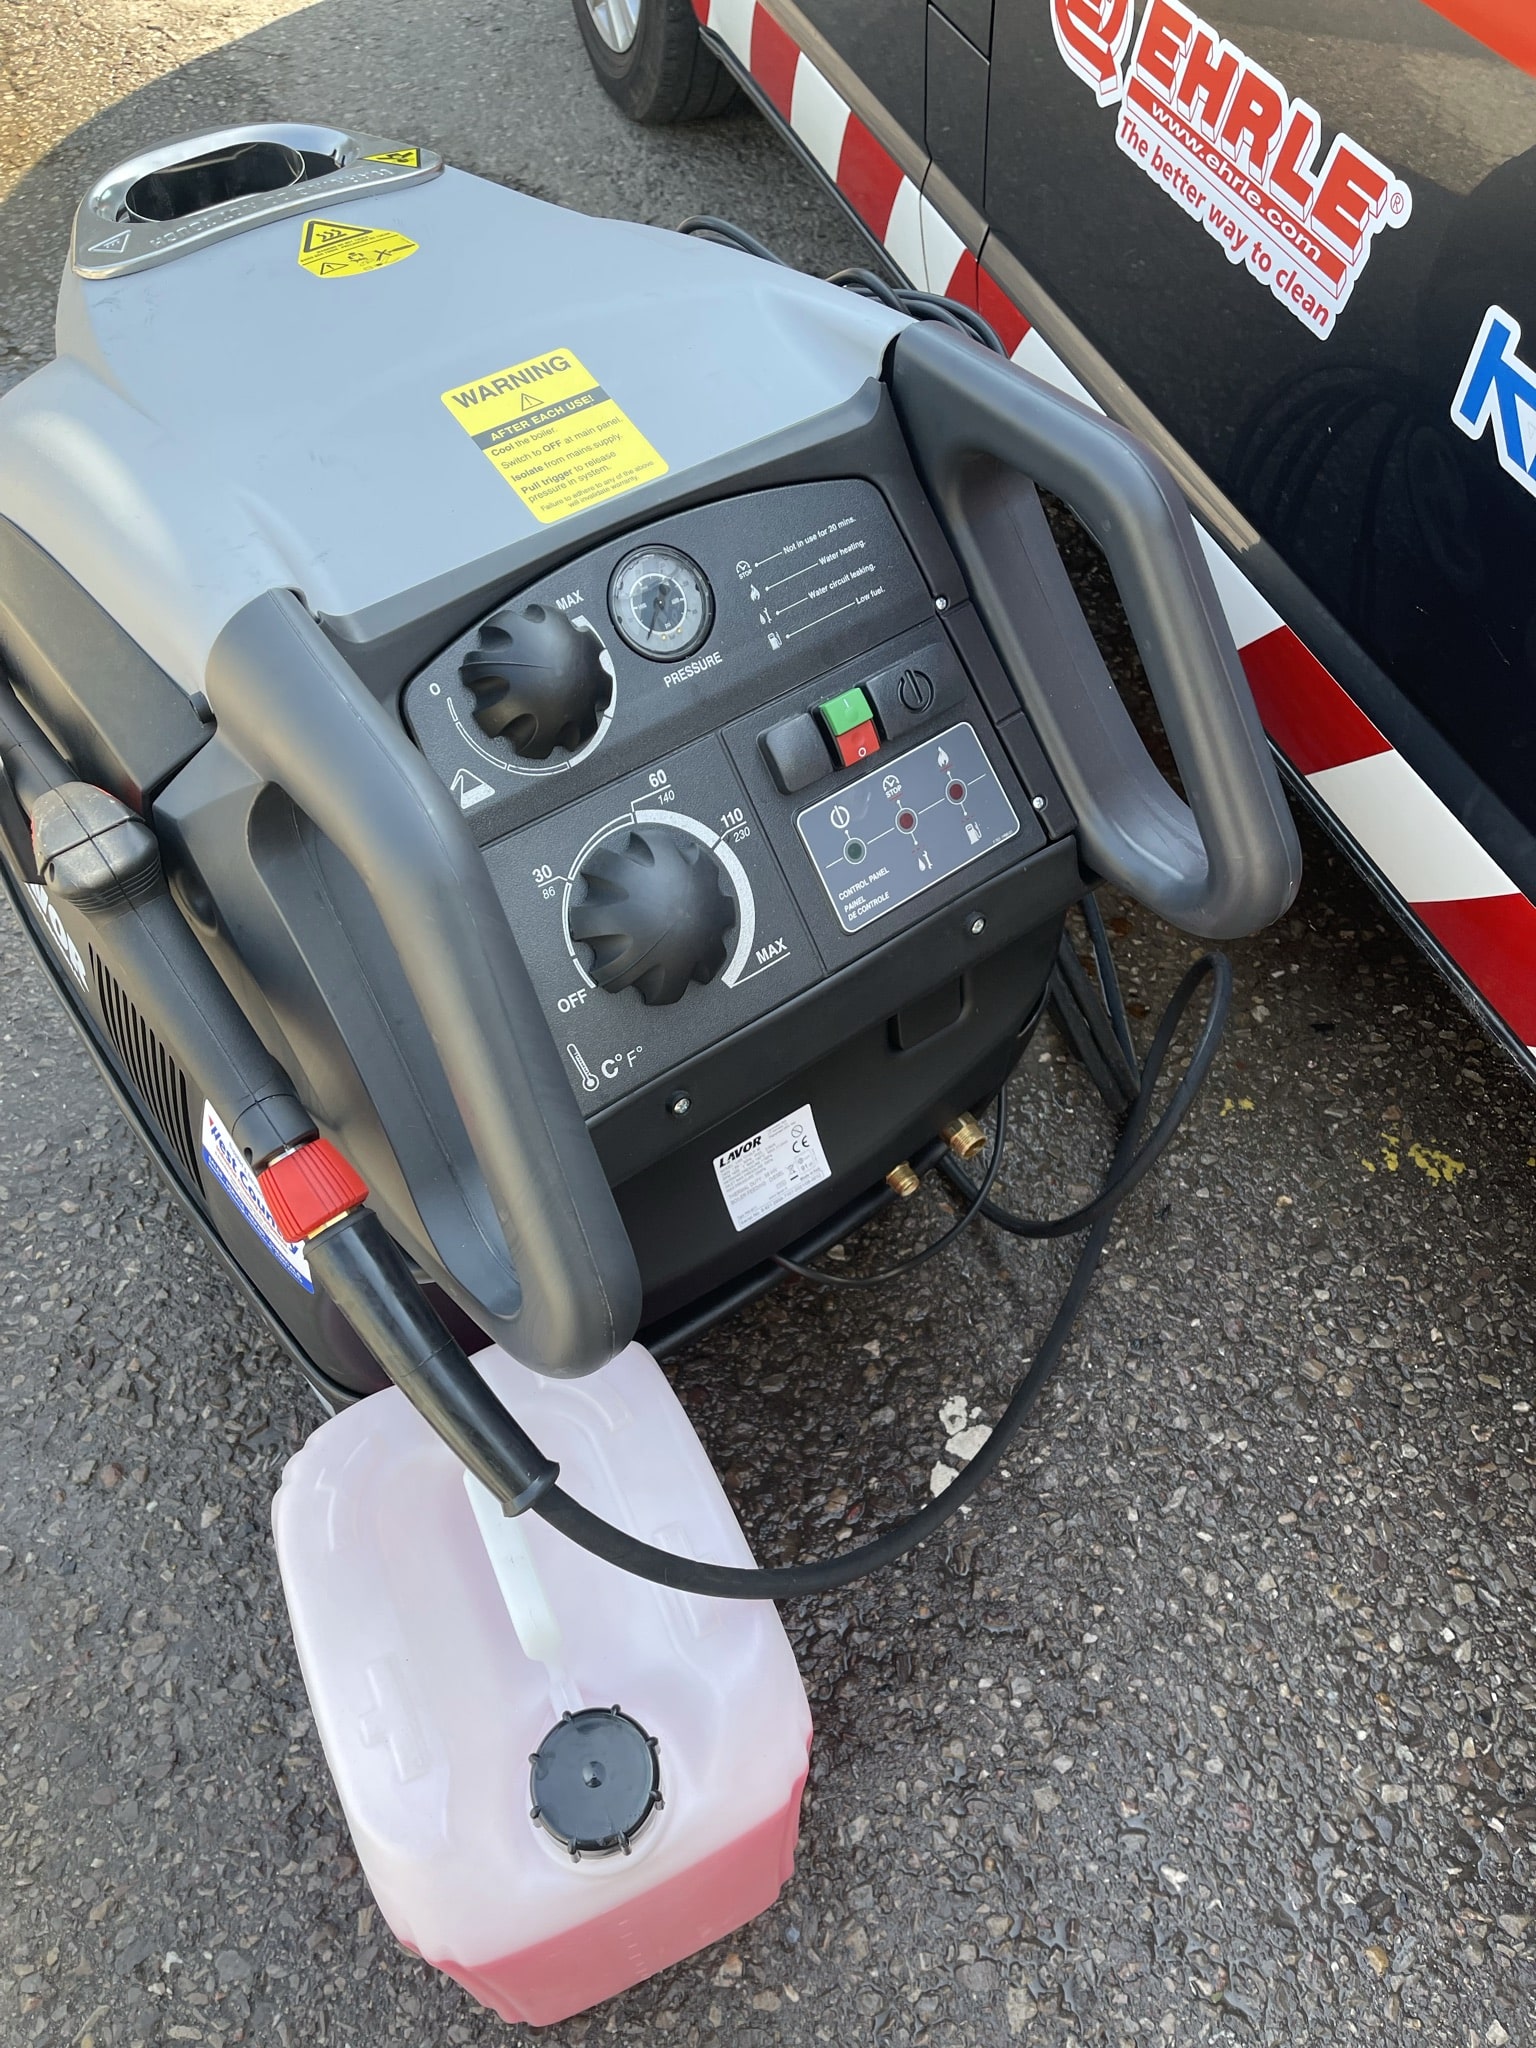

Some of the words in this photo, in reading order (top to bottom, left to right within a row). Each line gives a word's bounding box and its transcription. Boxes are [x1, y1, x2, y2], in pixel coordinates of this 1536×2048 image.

[1136, 0, 1388, 266] EHRLE
[1151, 101, 1321, 262] www.ehrle.com
[1120, 115, 1149, 158] The
[1150, 144, 1207, 209] better
[1208, 203, 1249, 252] way
[1251, 241, 1272, 272] to
[1275, 269, 1329, 327] clean
[451, 356, 572, 409] WARNING
[490, 420, 531, 442] AFTER
[531, 406, 566, 425] EACH
[565, 394, 595, 411] USE!
[491, 443, 515, 457] Cool
[514, 437, 530, 448] the
[529, 427, 558, 441] boiler.
[501, 452, 532, 470] Switch
[531, 449, 542, 458] to
[542, 439, 562, 452] OFF
[563, 436, 574, 444] at
[574, 427, 596, 440] main
[596, 416, 623, 432] panel.
[510, 465, 544, 482] Isolate
[543, 456, 566, 469] from
[565, 445, 593, 460] mains
[593, 433, 623, 449] supply.
[520, 481, 542, 494] Pull
[541, 468, 573, 486] trigger
[573, 465, 584, 473] to
[584, 451, 617, 467] release
[528, 482, 568, 504] pressure
[567, 477, 578, 486] in
[577, 464, 612, 482] system.
[782, 543, 797, 554] Not
[796, 540, 805, 548] in
[804, 534, 817, 544] use
[817, 528, 828, 537] for
[828, 523, 838, 533] 20
[837, 516, 857, 528] mins.
[818, 551, 839, 565] Water
[839, 540, 866, 555] heating.
[807, 585, 828, 599] Water
[829, 574, 850, 589] circuit
[850, 563, 876, 579] leaking.
[855, 593, 870, 605] Low
[870, 586, 886, 597] fuel.
[555, 589, 584, 611] MAX
[663, 651, 723, 688] PRESSURE
[649, 769, 667, 788] 60
[885, 784, 902, 798] STOP
[658, 789, 675, 806] 140
[720, 807, 744, 829] 110
[733, 826, 751, 842] 230
[532, 864, 552, 883] 30
[838, 879, 869, 900] CONTROL
[868, 866, 890, 883] PANEL
[542, 886, 556, 900] 86
[844, 895, 866, 913] PAINEL
[847, 910, 858, 921] DE
[857, 891, 890, 915] CONTROLE
[755, 937, 788, 964] MAX
[557, 988, 587, 1014] OFF
[720, 1136, 762, 1168] LAVOR
[209, 1115, 237, 1172] West
[239, 1170, 299, 1255] Couny
